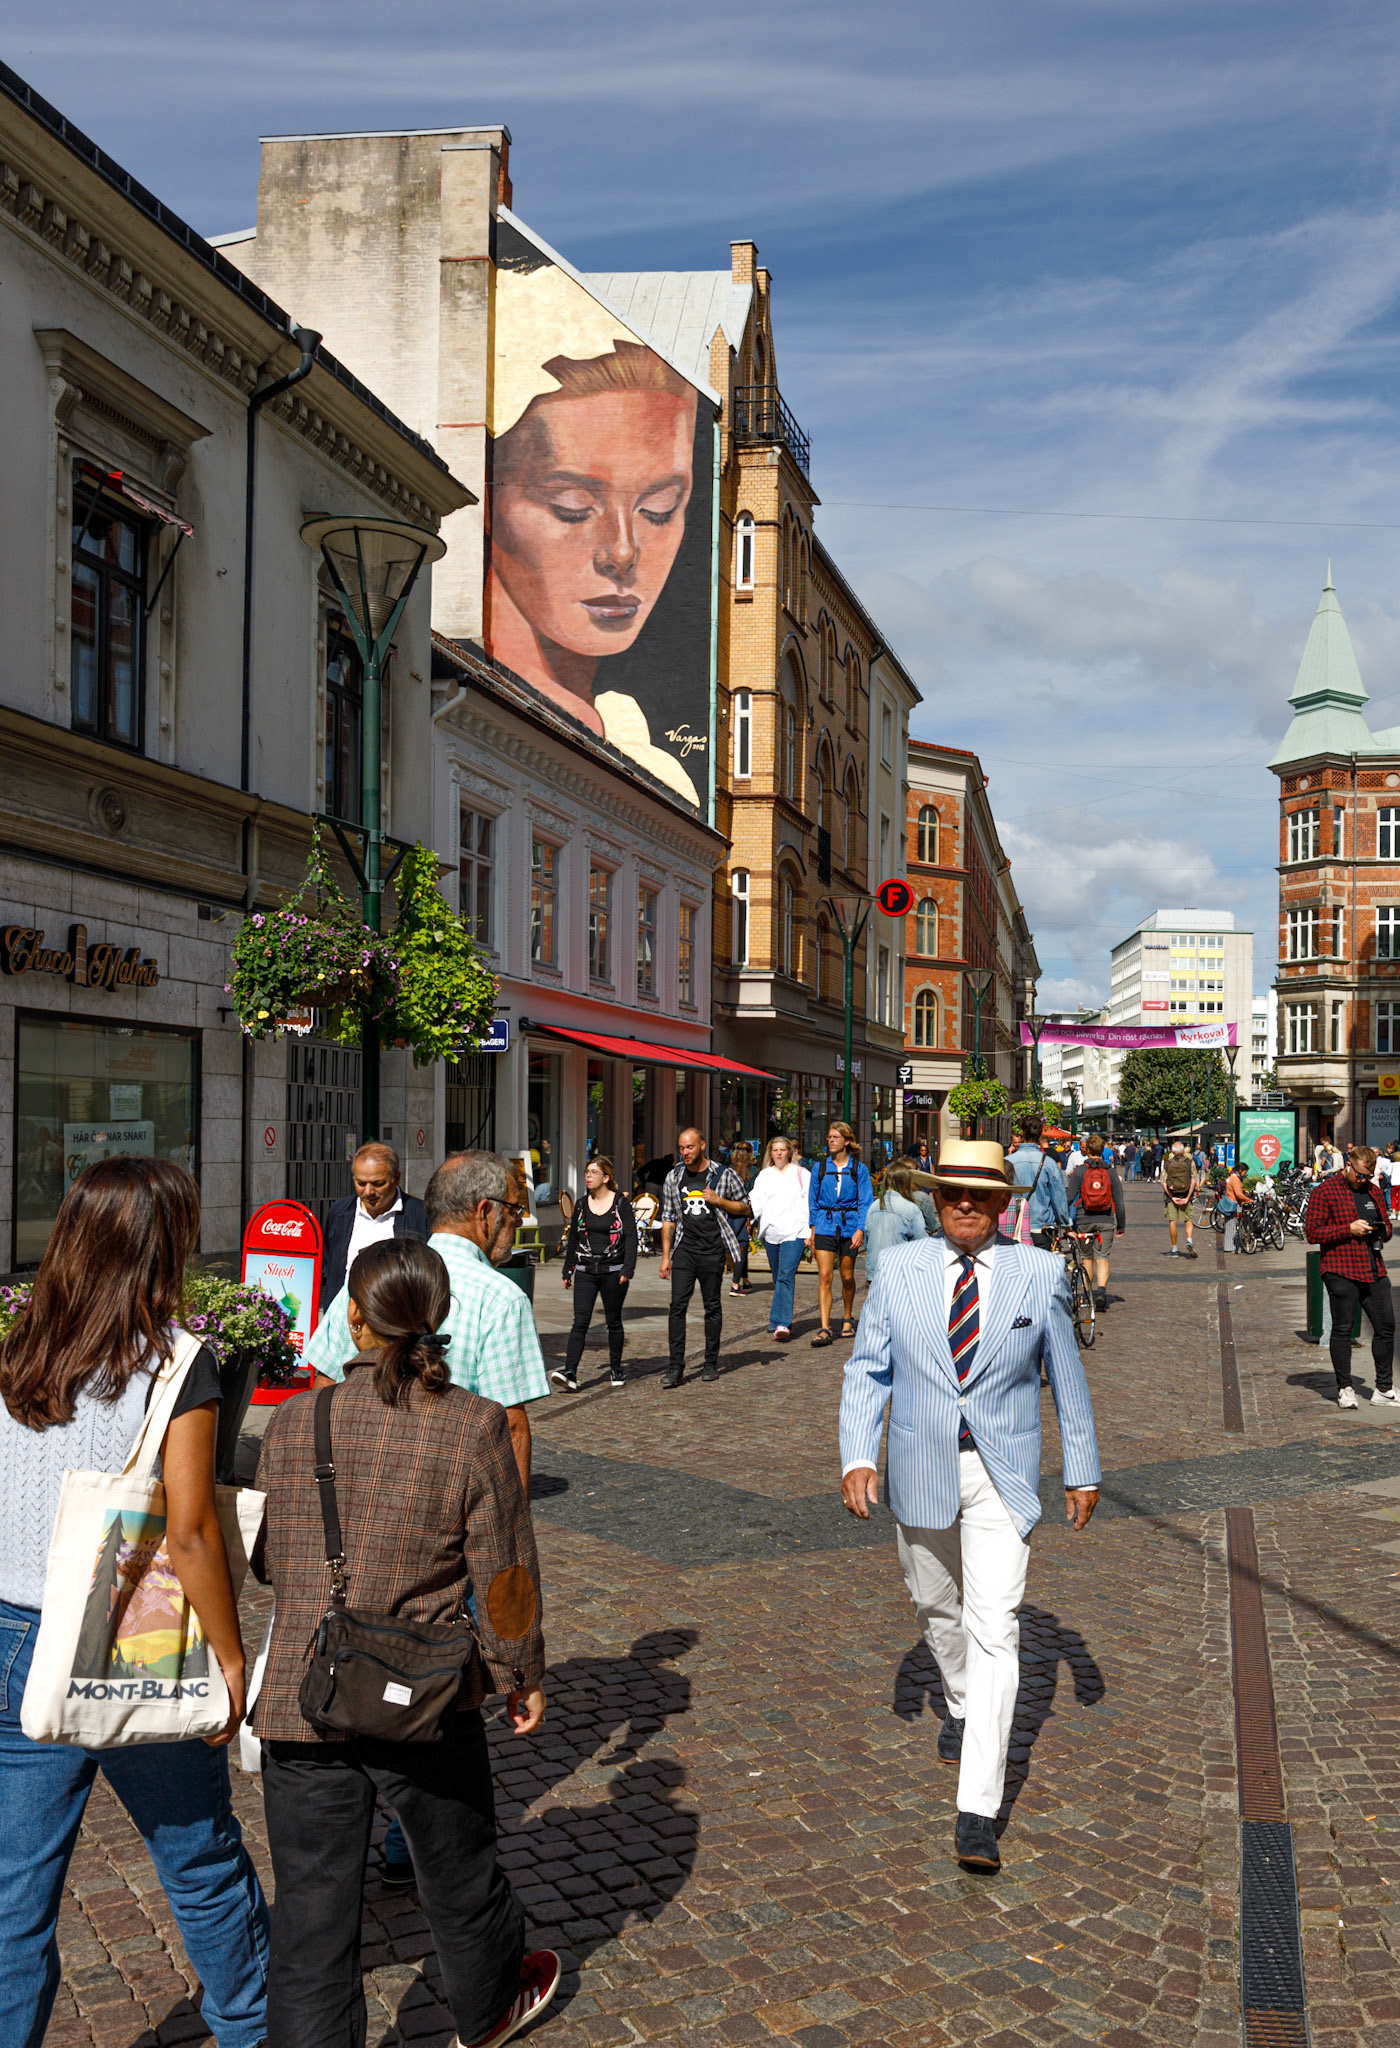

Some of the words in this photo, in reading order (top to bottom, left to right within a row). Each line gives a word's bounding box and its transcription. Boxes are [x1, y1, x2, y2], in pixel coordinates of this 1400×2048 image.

[664, 724, 707, 757] Vargas
[887, 887, 901, 908] F
[1, 924, 74, 976] Choco
[1122, 1033, 1138, 1041] röst
[1180, 1028, 1224, 1043] Kyrkoval
[915, 1095, 932, 1104] Telia
[72, 1131, 89, 1143] HÄR
[90, 1130, 122, 1143] ÖNAR
[123, 1131, 147, 1142] SNART
[261, 1218, 305, 1237] Coca-Cola
[264, 1262, 295, 1278] Slush
[66, 1680, 209, 1700] MONT-BLANC
